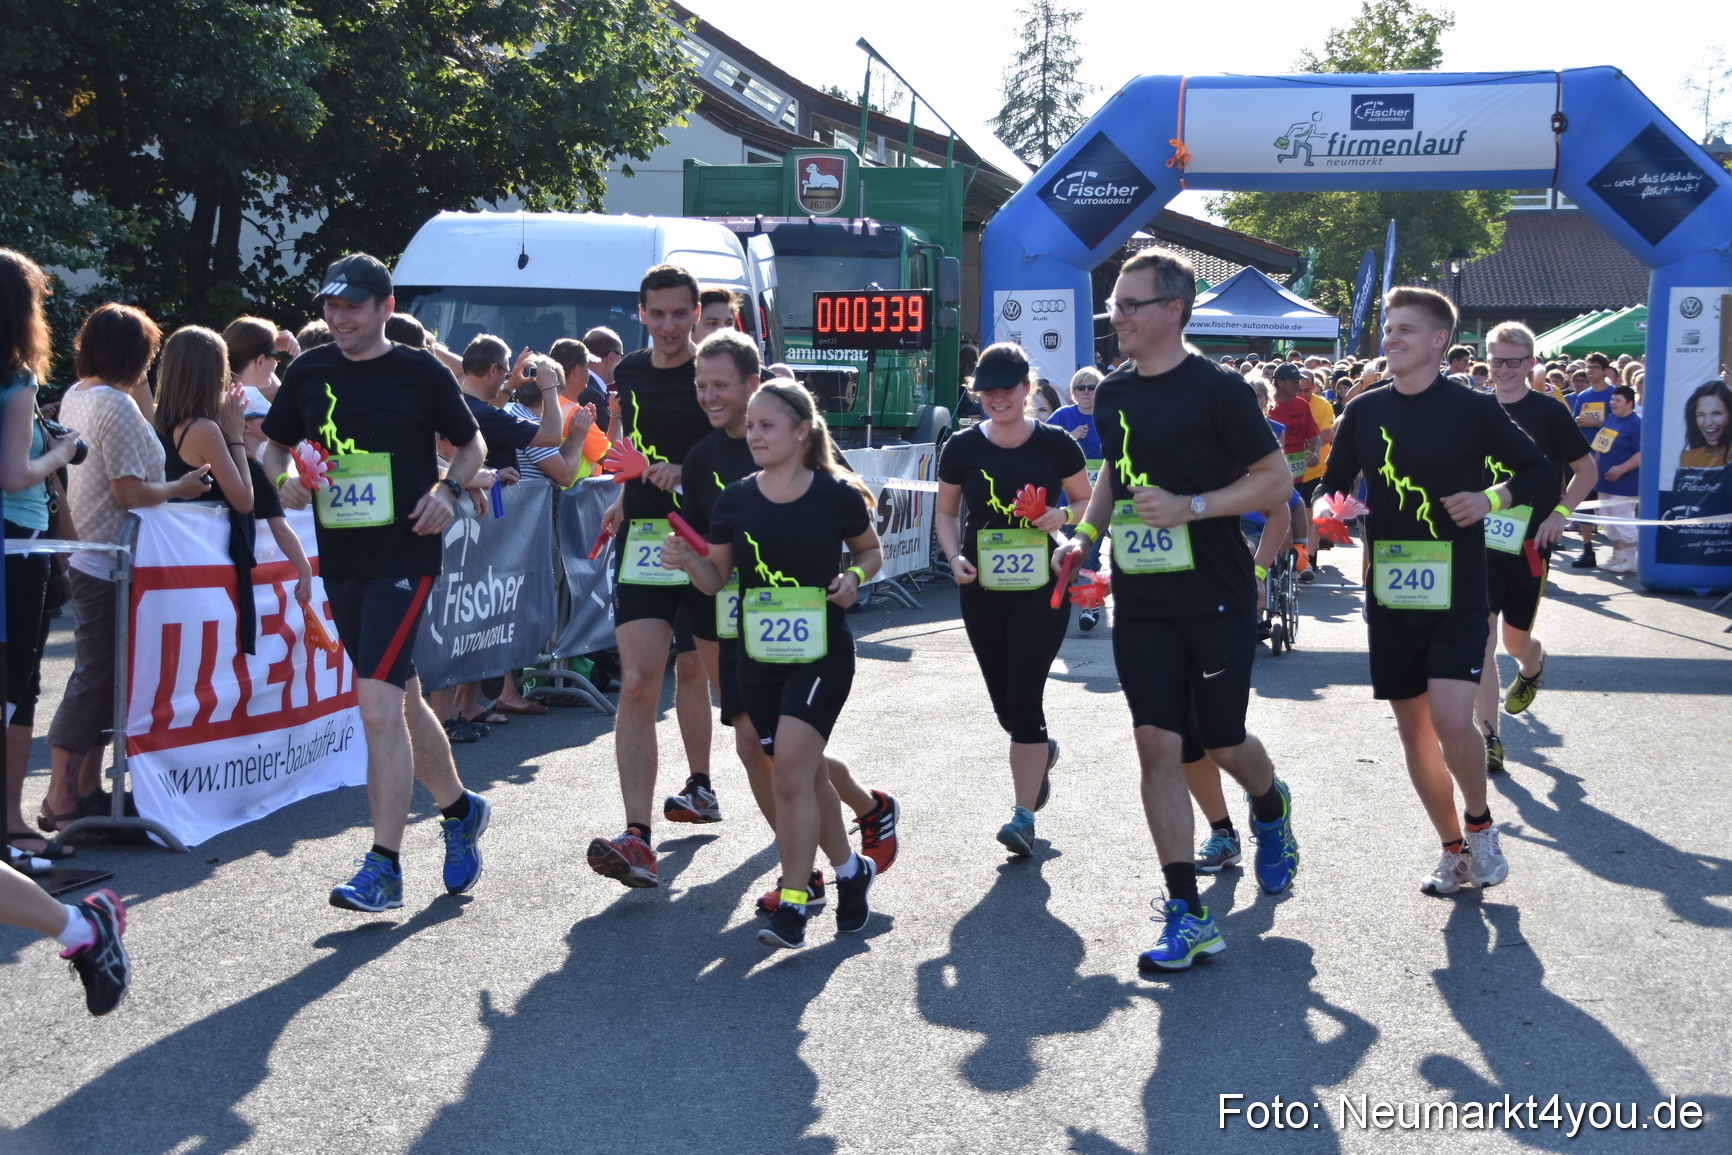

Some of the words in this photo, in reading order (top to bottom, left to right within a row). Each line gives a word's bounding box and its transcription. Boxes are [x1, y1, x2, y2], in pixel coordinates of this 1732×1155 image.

[1364, 108, 1411, 117] Fischer
[1327, 130, 1468, 156] firmenlauf
[1326, 157, 1383, 166] neumarkt
[1638, 173, 1659, 184] das
[1067, 183, 1139, 197] Fischer
[809, 200, 831, 209] 1628
[817, 296, 923, 332] 000339
[1189, 321, 1302, 331] www.fischer-automobile.de
[1044, 335, 1058, 346] FIAT
[1598, 436, 1609, 447] 745
[1291, 461, 1305, 472] 533
[329, 483, 376, 508] 244
[1484, 516, 1514, 538] 239
[1124, 528, 1173, 553] 246
[637, 546, 663, 567] 23
[992, 553, 1035, 574] 232
[1388, 568, 1435, 590] 240
[443, 565, 525, 626] Fischer
[451, 622, 515, 658] AUTOMOBILE
[759, 618, 809, 642] 226
[127, 575, 355, 737] MEIE
[159, 714, 354, 798] www.meier-baustoffe.de
